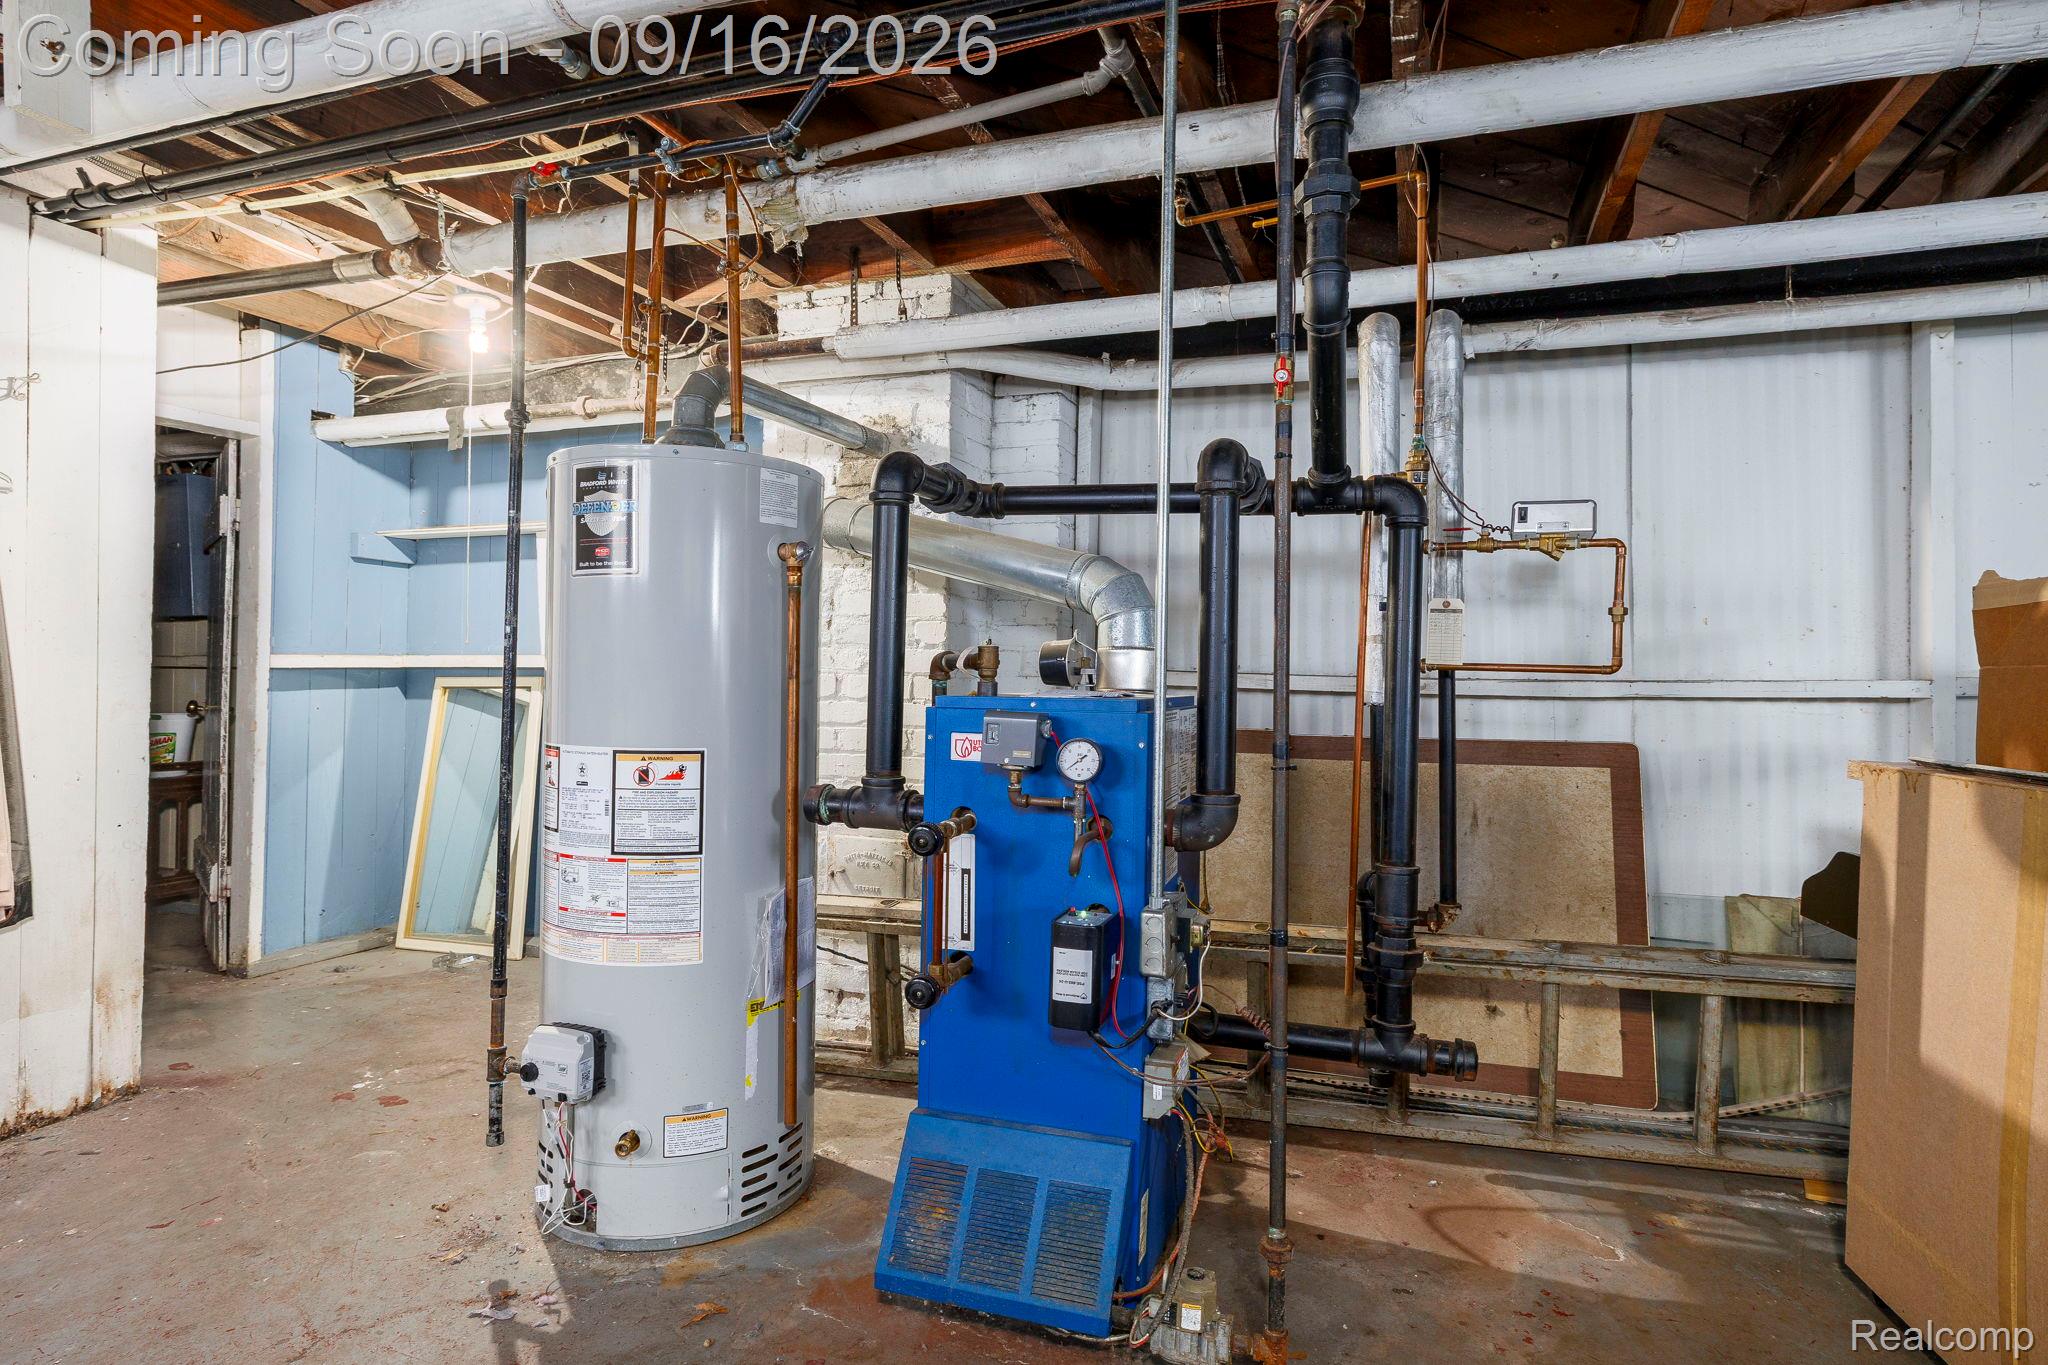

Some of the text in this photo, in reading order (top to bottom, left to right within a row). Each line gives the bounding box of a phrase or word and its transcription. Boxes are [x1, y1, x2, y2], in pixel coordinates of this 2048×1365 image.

[580, 480, 607, 488] BRADFORD
[572, 500, 639, 516] DEFENDER
[686, 1113, 712, 1121] WARNING
